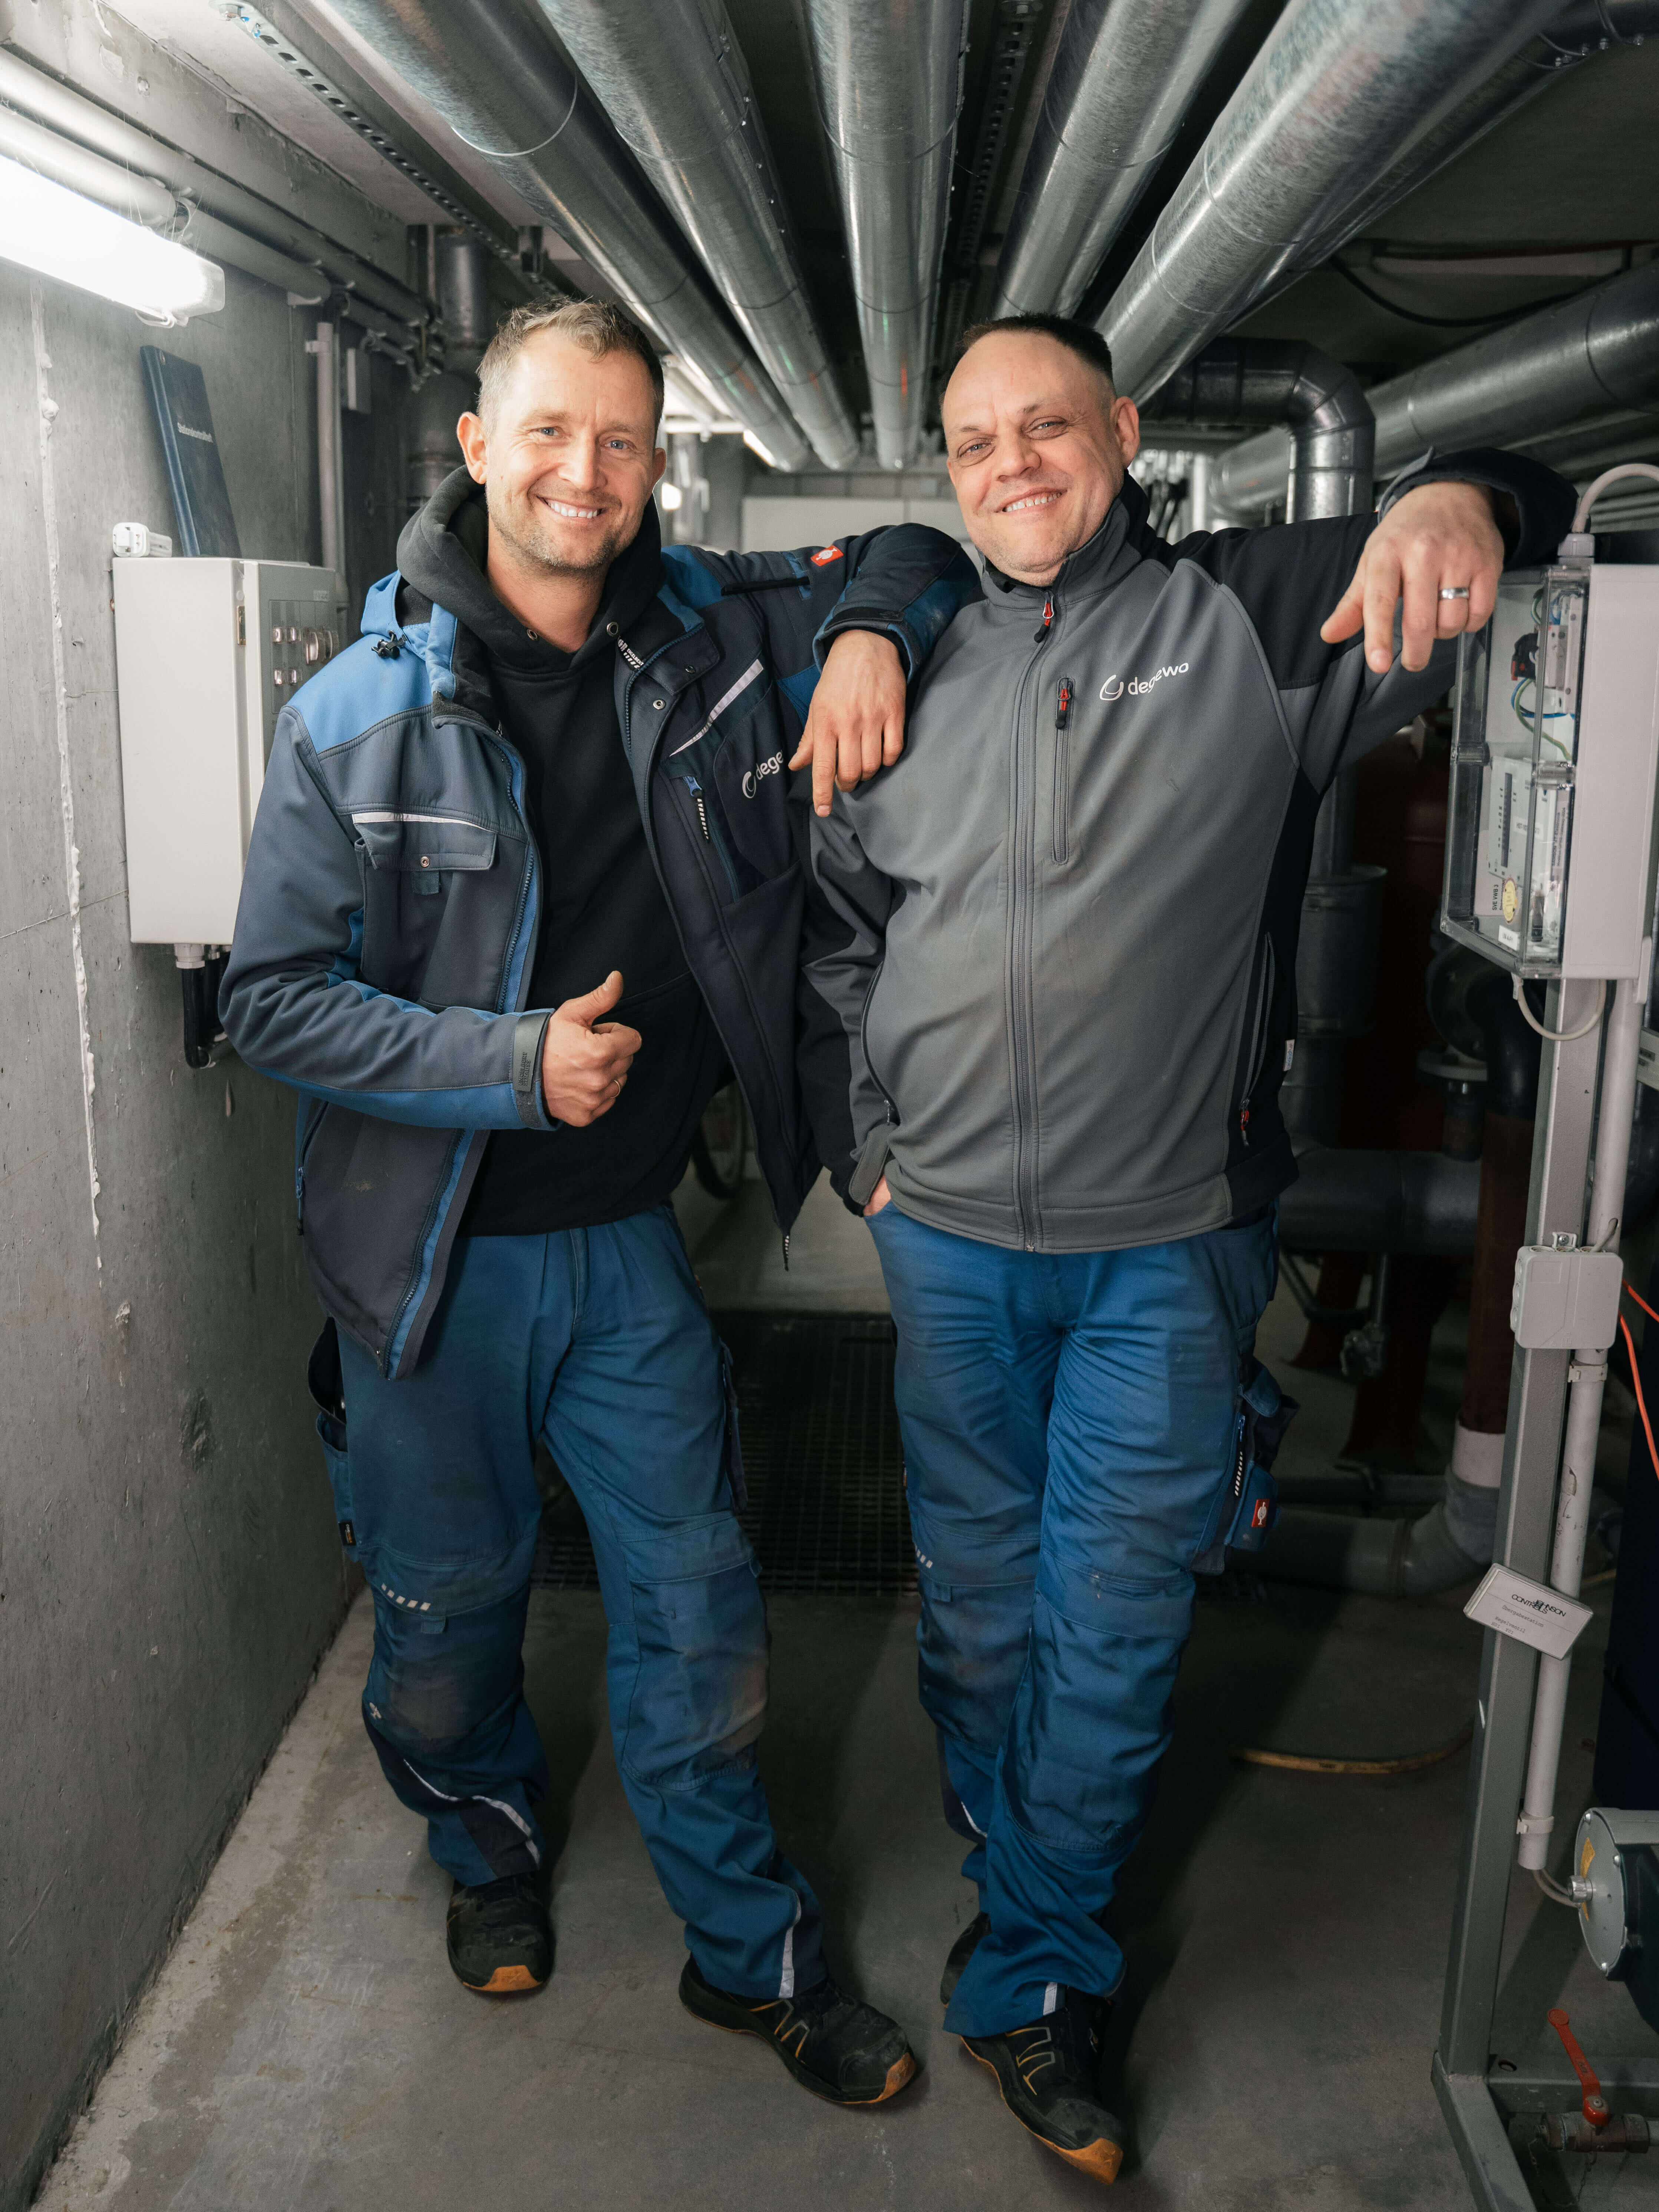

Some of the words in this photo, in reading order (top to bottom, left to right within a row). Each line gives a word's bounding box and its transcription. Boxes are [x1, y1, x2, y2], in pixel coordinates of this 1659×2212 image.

[1128, 663, 1189, 695] degewo
[756, 750, 784, 780] dege
[518, 1051, 527, 1086] ENGELBERT
[1511, 1594, 1548, 1614] CONTROLS
[1534, 1599, 1566, 1617] JOHNSON
[1495, 1616, 1526, 1634] Regelventil
